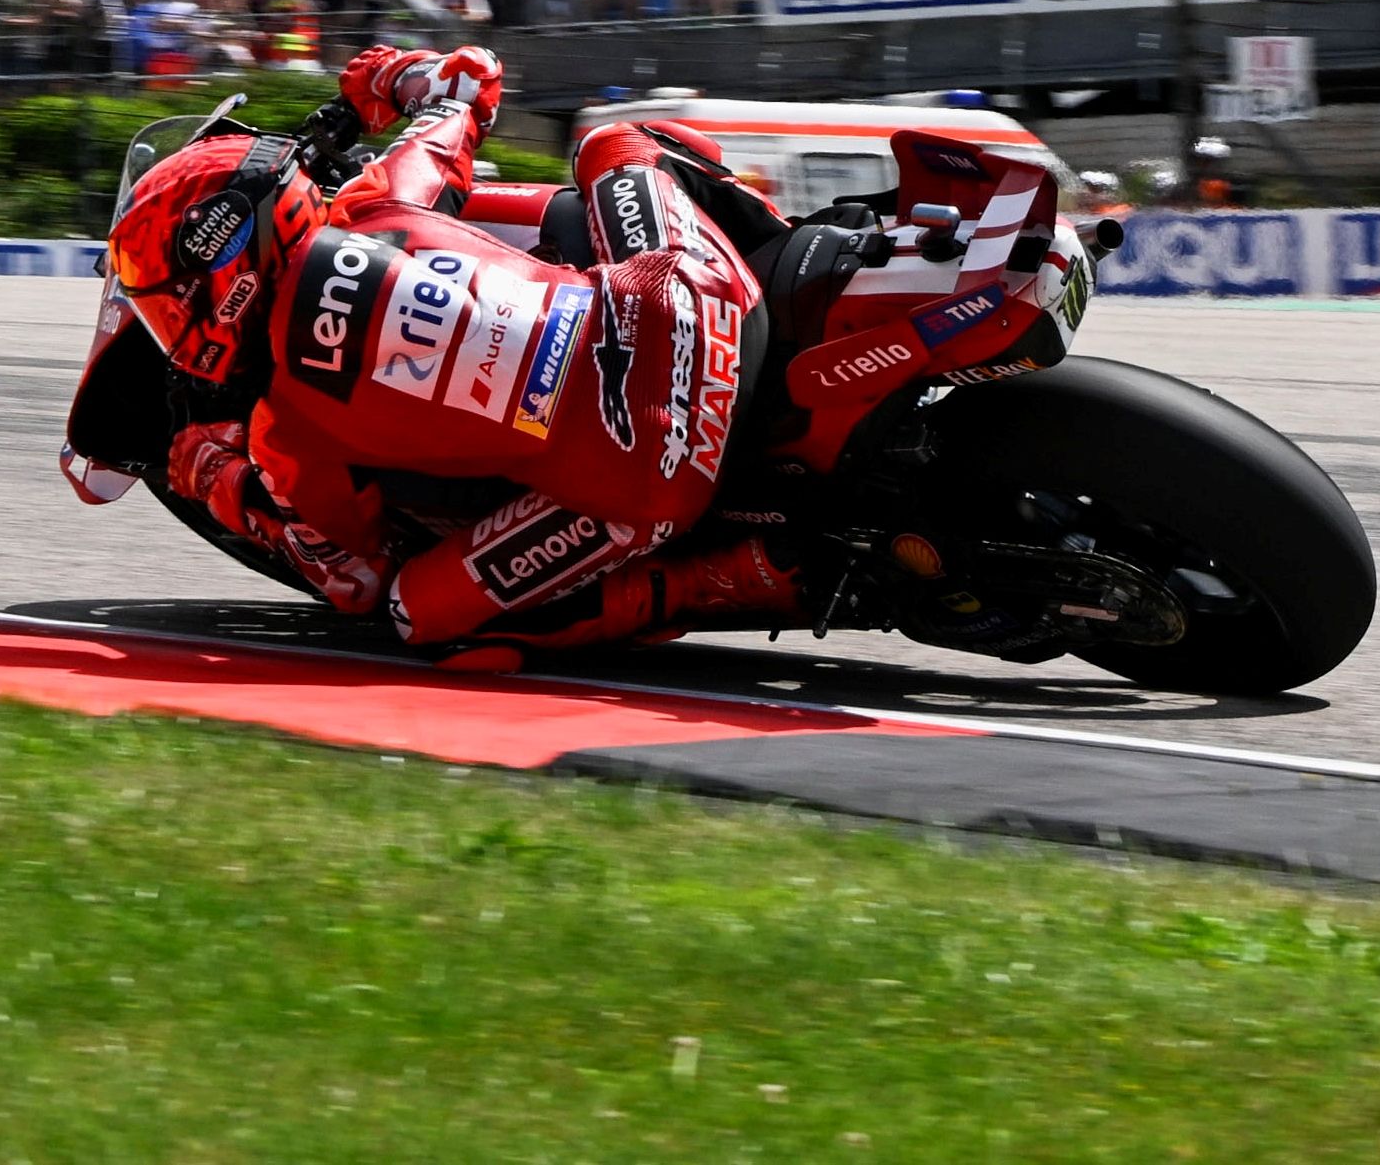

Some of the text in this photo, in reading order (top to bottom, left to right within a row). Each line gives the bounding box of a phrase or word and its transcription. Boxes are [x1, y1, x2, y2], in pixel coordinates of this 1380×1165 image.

[939, 153, 978, 171] TIM
[185, 201, 230, 254] Estrella
[198, 213, 241, 261] Galicia
[798, 235, 822, 275] DUCATI
[220, 278, 255, 320] SHOEI
[399, 256, 462, 347] rieo
[944, 295, 995, 322] TIM
[479, 322, 507, 378] Audi
[540, 292, 580, 388] MICHELIN
[833, 343, 912, 382] riello
[689, 293, 742, 483] MARC
[488, 515, 597, 589] Lenovo
